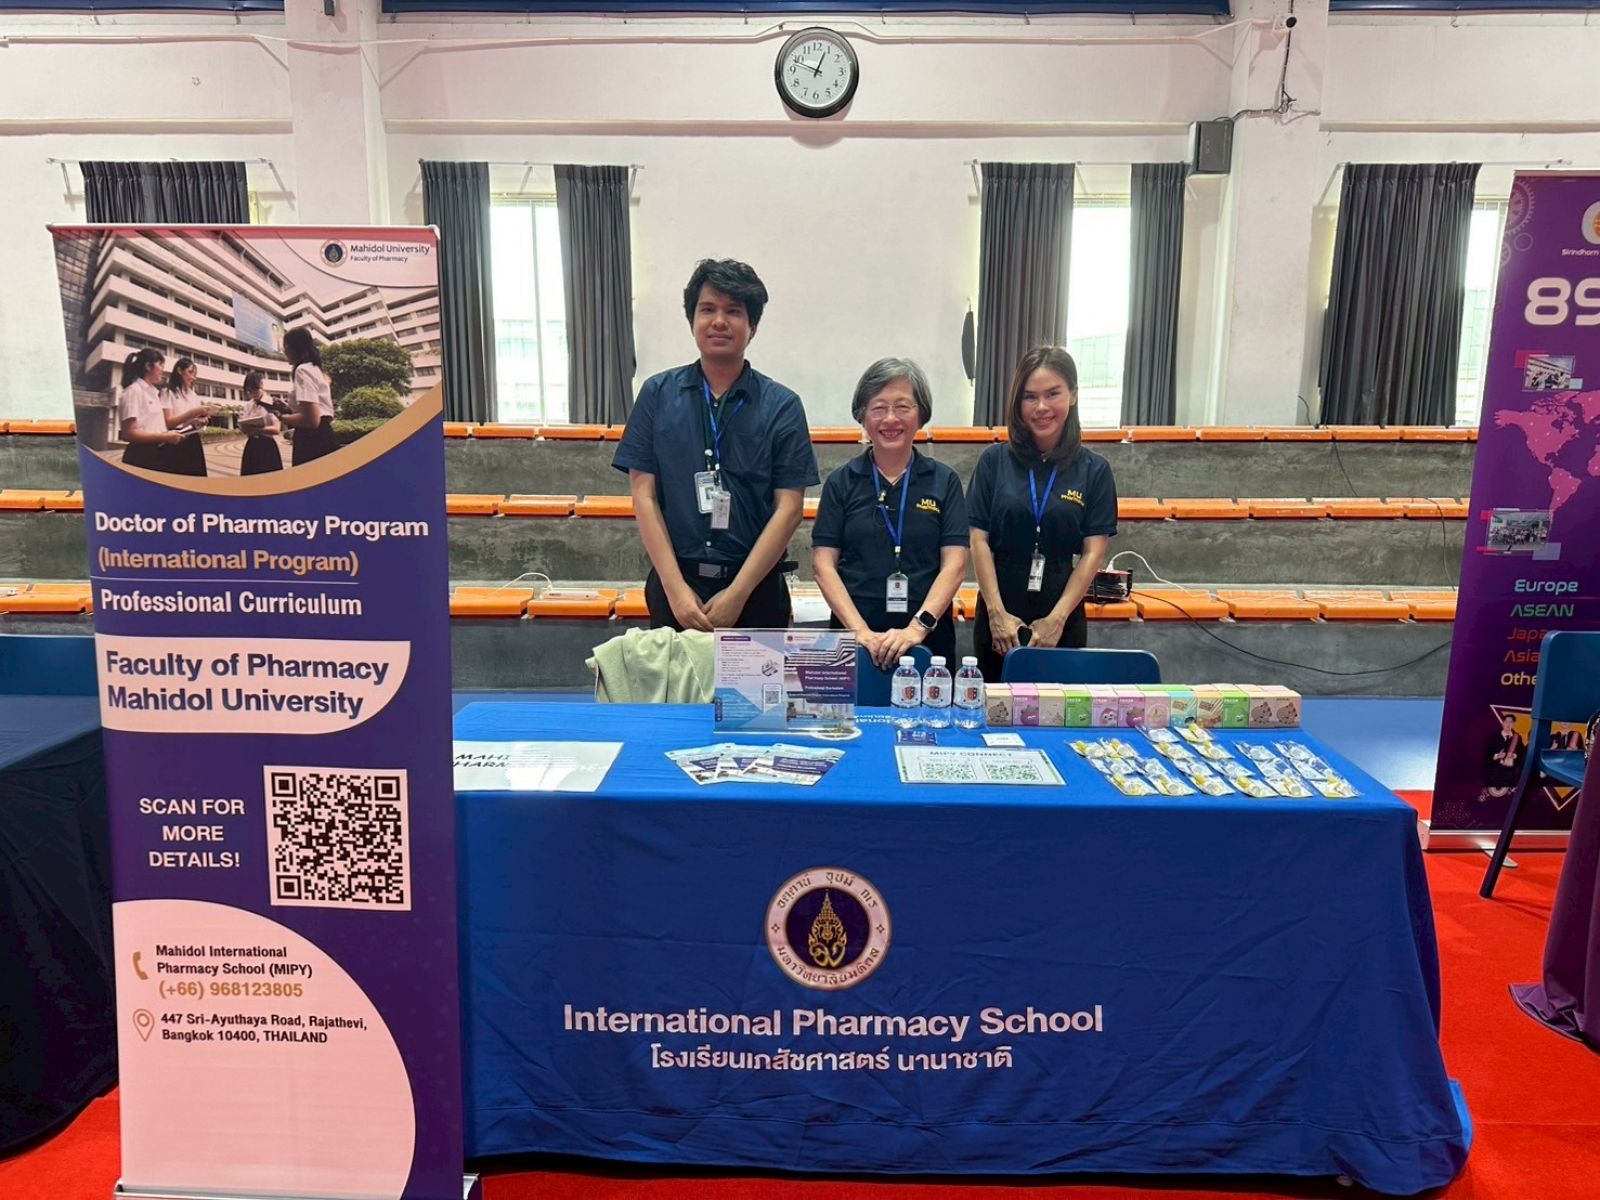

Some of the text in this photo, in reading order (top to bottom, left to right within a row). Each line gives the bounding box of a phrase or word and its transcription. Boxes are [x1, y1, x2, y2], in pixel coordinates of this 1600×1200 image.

[803, 46, 811, 54] 11
[813, 42, 823, 51] 12
[834, 54, 840, 63] 2
[789, 66, 796, 74] 9
[839, 67, 844, 76] 3
[793, 78, 799, 87] 8
[803, 87, 809, 96] 7
[812, 90, 820, 99] 6
[825, 88, 831, 96] 5
[350, 244, 430, 255] Mahidol University
[1561, 248, 1599, 256] Sirindhorn
[350, 255, 370, 263] Faculty
[1067, 489, 1082, 499] MU
[921, 498, 936, 507] MU
[95, 511, 429, 542] Doctor of Pharmacy Program
[98, 546, 360, 577] (International Program)
[1514, 579, 1579, 596] Europe
[101, 588, 362, 615] Professional Curriculum
[1510, 604, 1575, 617] ASEAN
[1506, 627, 1548, 643] Japa
[106, 650, 389, 686] Faculty of Pharmacy
[1500, 671, 1537, 686] Othe
[107, 684, 364, 719] Mahidol University
[139, 797, 245, 815] SCAN FOR
[162, 825, 225, 841] MORE
[148, 851, 241, 868] DETAILS!
[156, 945, 287, 958] Mahidol International
[157, 962, 313, 978] Pharmacy School (MIPY)
[159, 980, 304, 1000] (+66) 968123805
[160, 1013, 368, 1031] 447 Sri-Ayuthaya Road, Rajathevi,
[563, 1003, 1104, 1042] International Pharmacy School
[162, 1029, 328, 1043] Bangkok 10400, THAILAND
[651, 1043, 1013, 1071] โรงเรียนเภสัชศาสตร์ นานาชาติ
